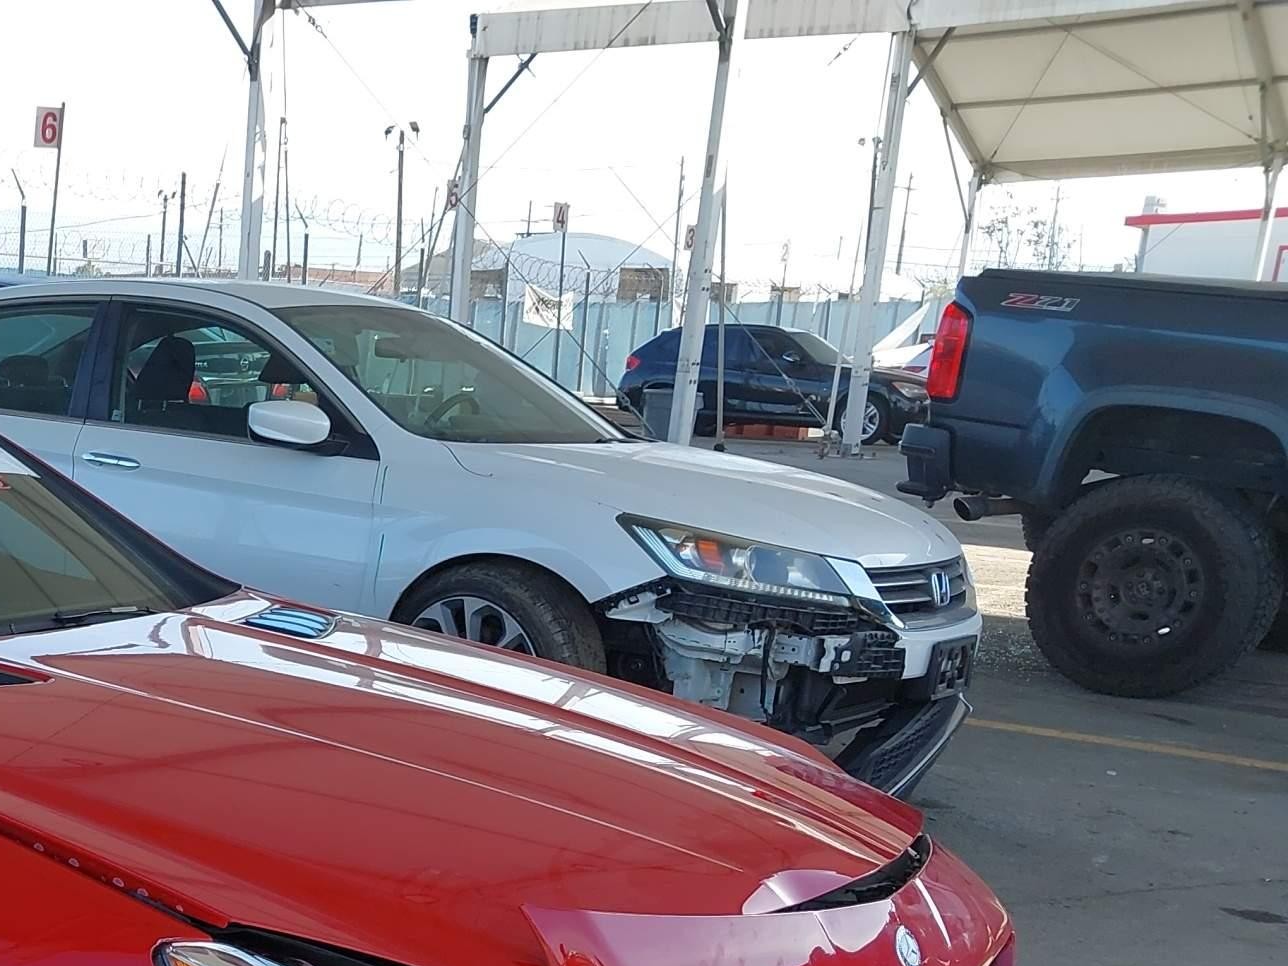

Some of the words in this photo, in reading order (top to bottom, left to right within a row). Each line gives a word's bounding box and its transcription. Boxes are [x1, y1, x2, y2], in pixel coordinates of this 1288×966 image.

[41, 111, 57, 144] 6
[556, 206, 565, 228] 4
[686, 228, 695, 249] 3
[781, 243, 790, 261] 2
[1000, 292, 1080, 312] Z71
